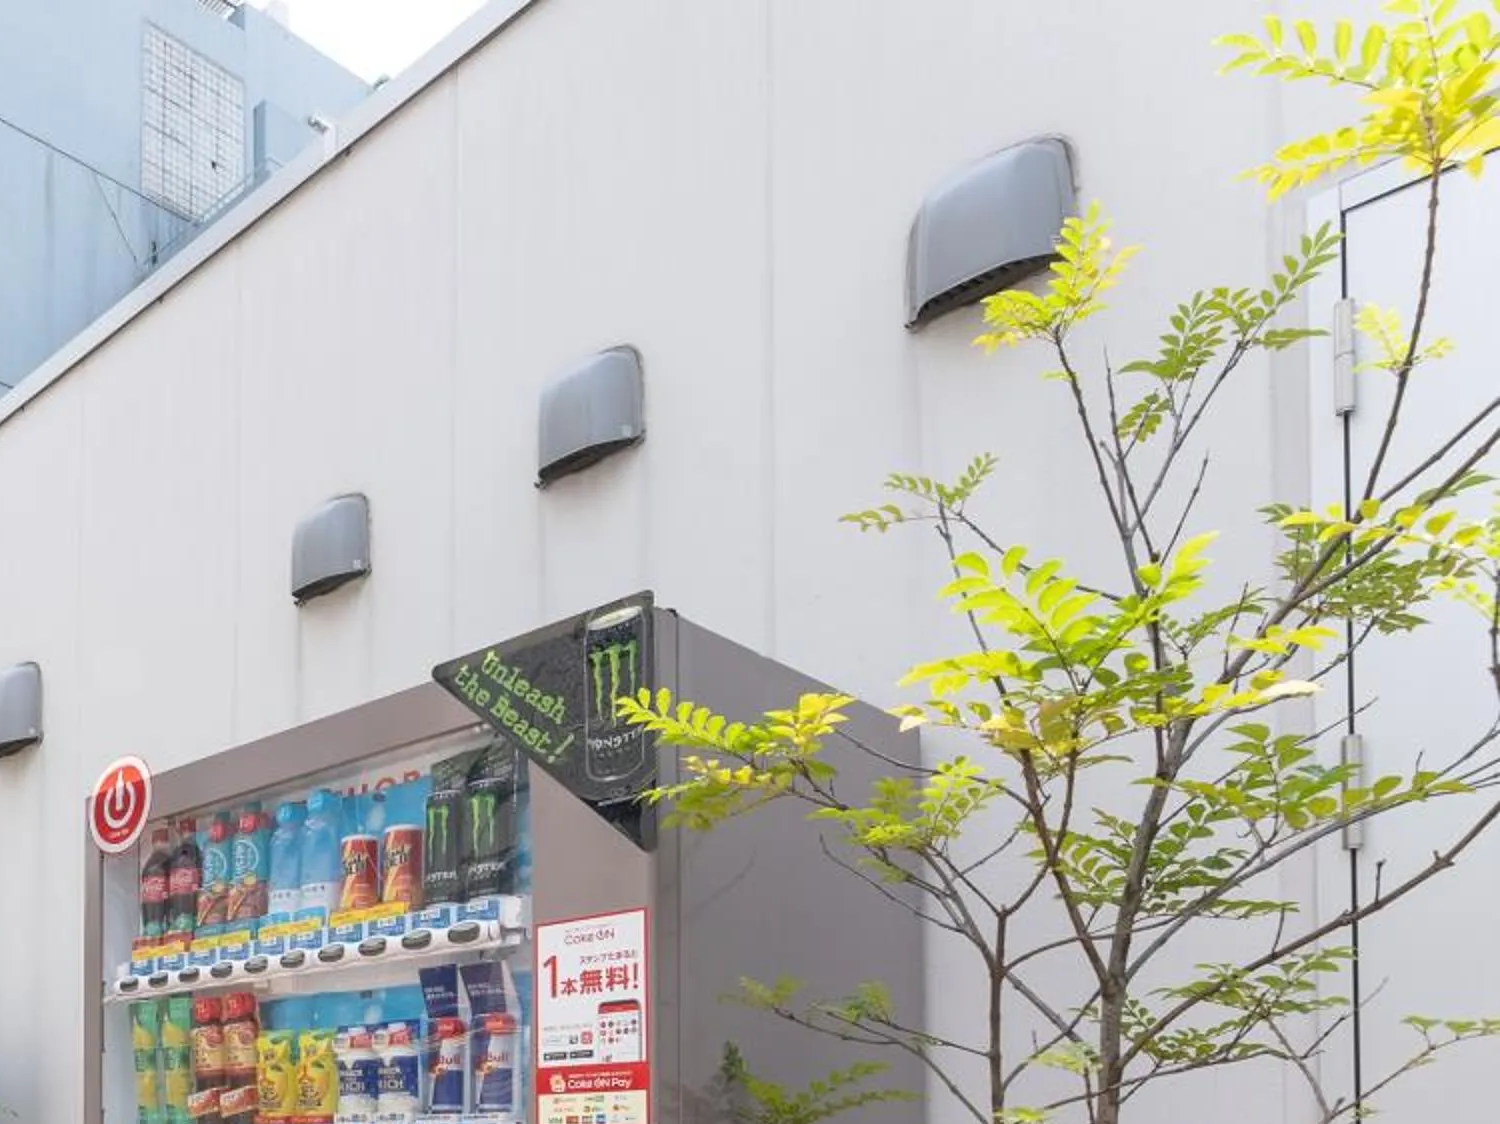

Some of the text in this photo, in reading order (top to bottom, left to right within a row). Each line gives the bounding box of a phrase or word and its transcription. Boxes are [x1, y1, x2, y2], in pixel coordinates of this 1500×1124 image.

[454, 664, 491, 707] the
[480, 649, 567, 725] Unleash
[611, 1077, 633, 1088] Pay
